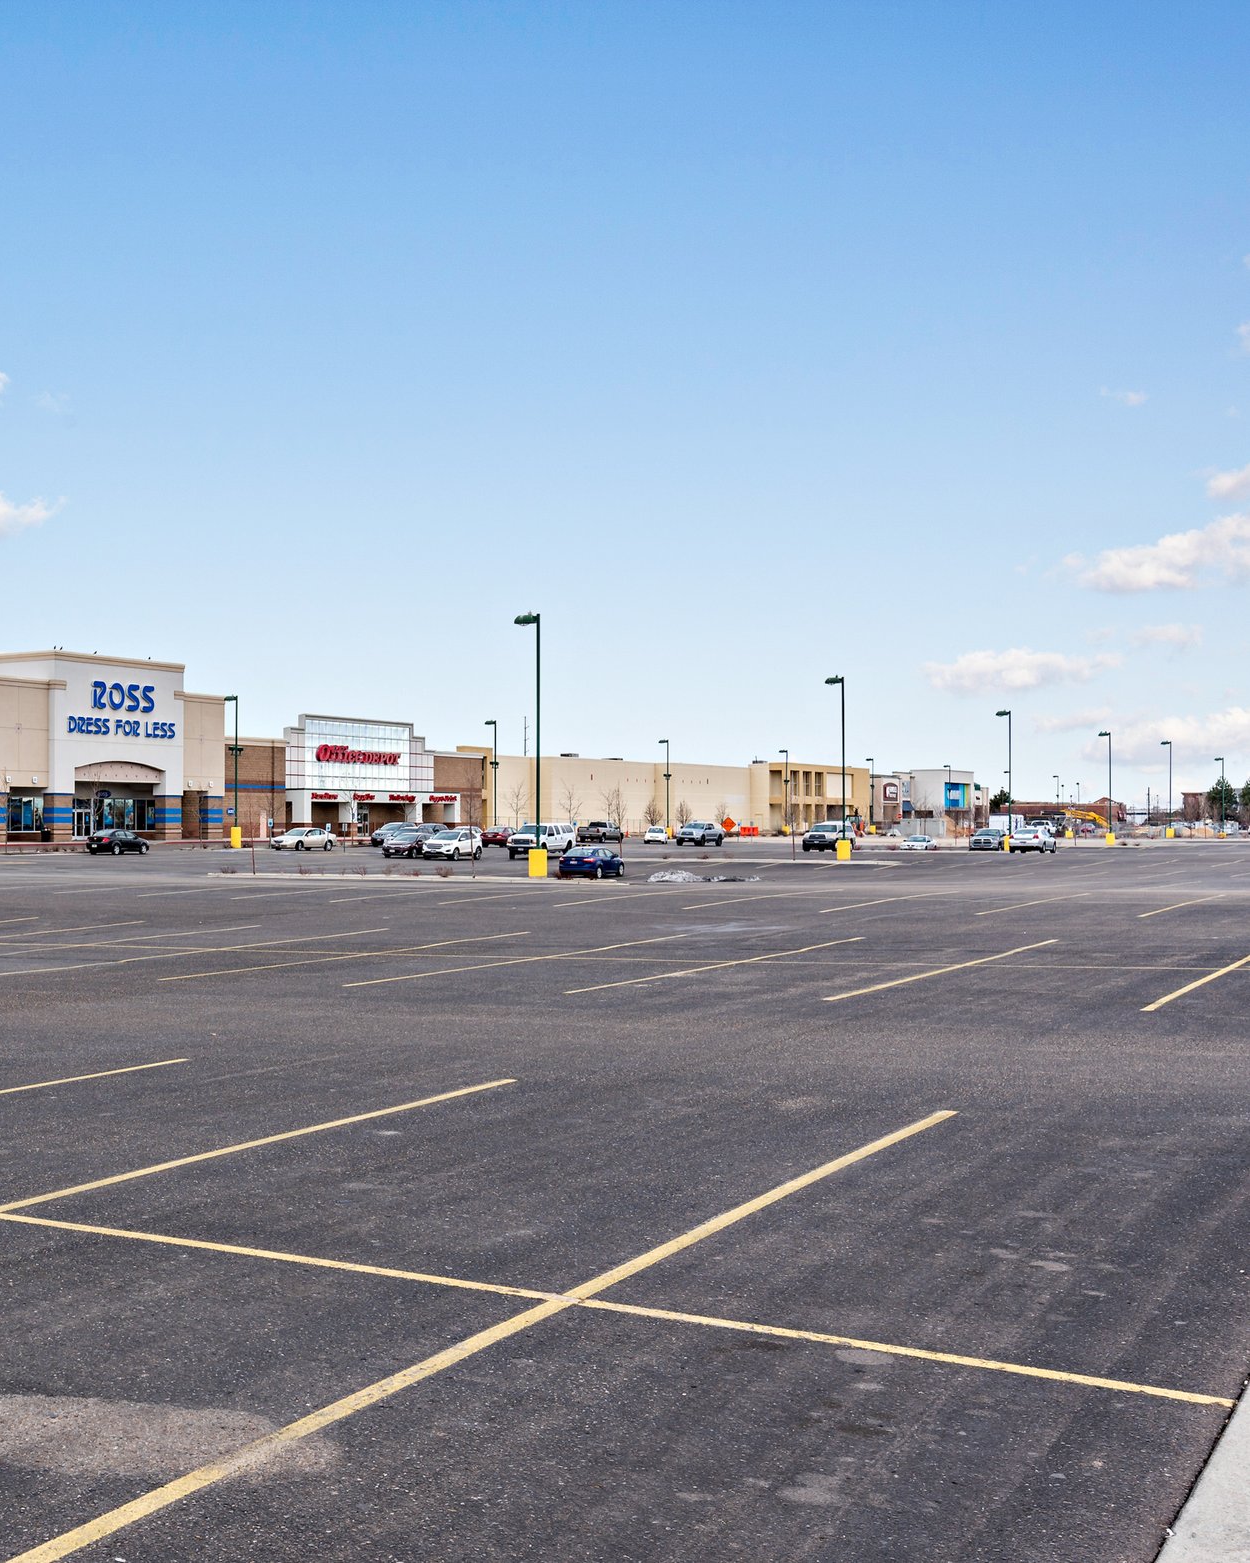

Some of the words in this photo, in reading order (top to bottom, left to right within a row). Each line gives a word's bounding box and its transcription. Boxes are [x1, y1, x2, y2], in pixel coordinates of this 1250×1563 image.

[91, 680, 155, 713] ROSS
[67, 715, 110, 735] DRESS
[114, 719, 141, 737] FOR
[144, 721, 176, 739] LESS
[364, 751, 402, 766] DEPOT
